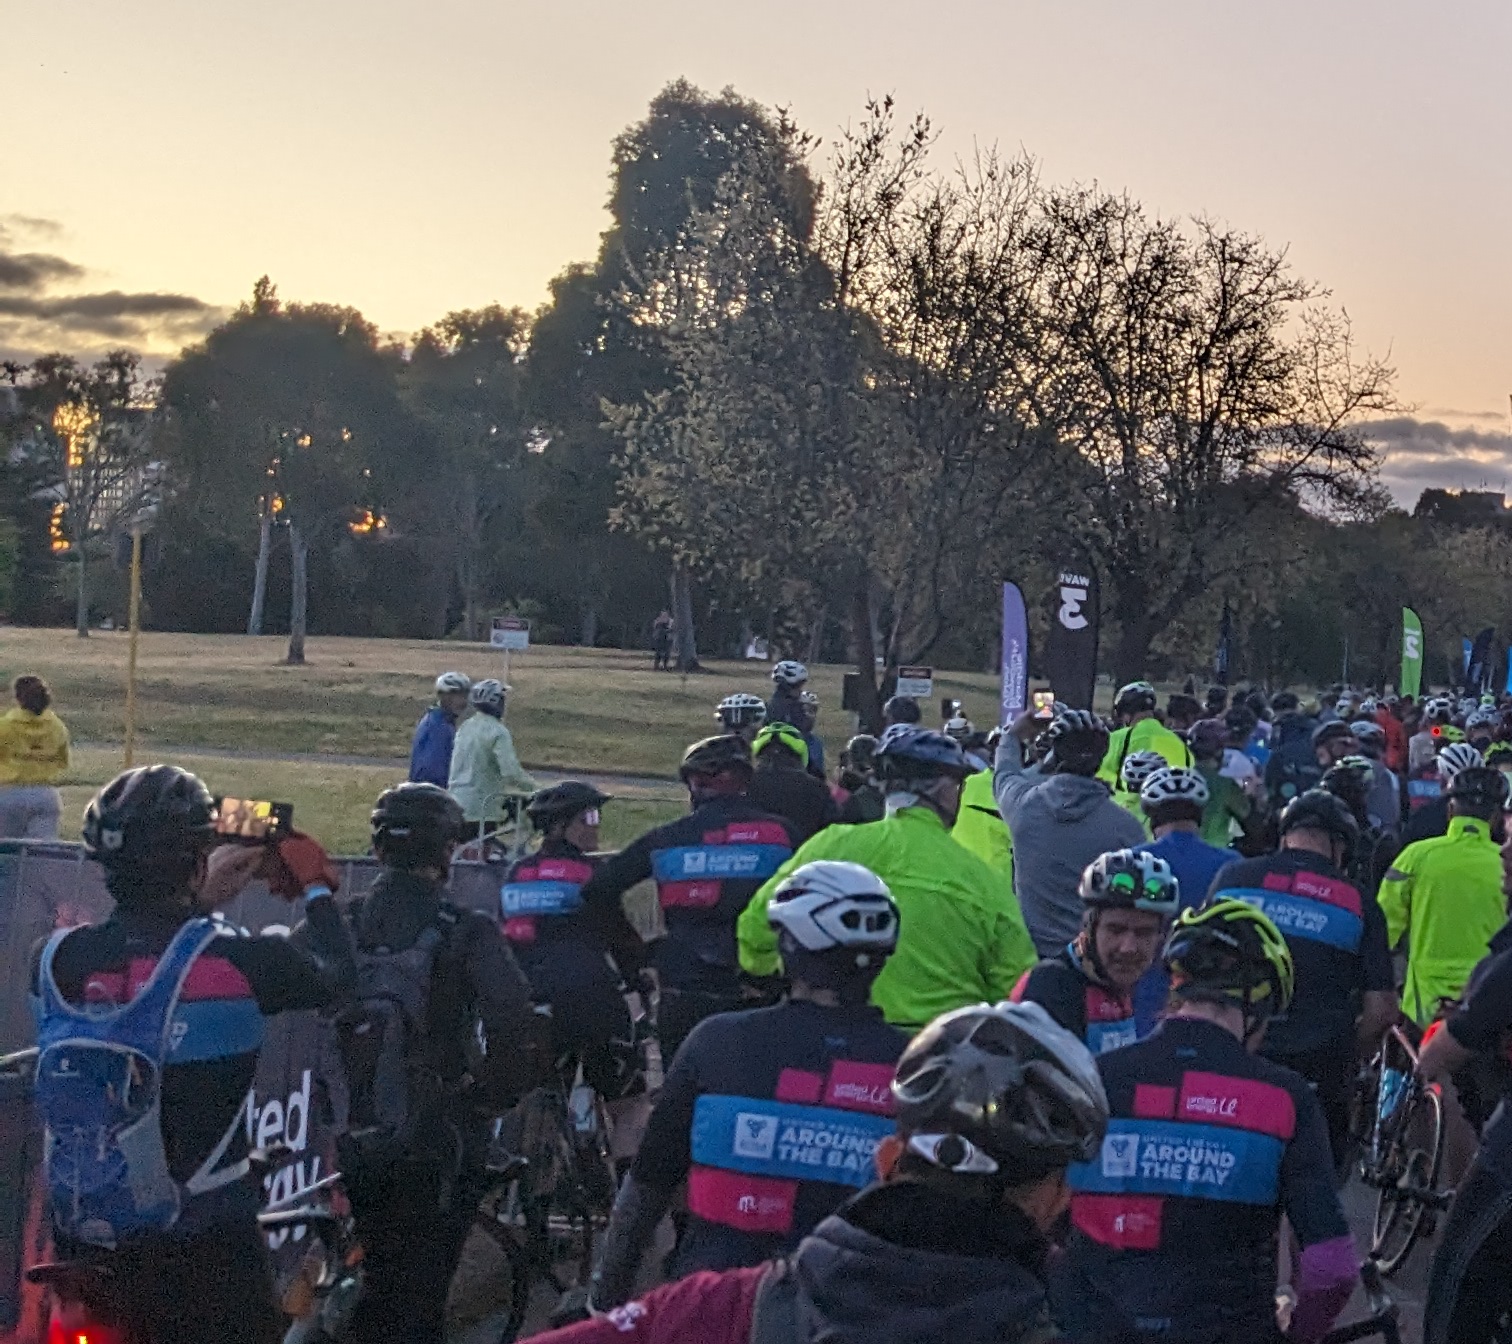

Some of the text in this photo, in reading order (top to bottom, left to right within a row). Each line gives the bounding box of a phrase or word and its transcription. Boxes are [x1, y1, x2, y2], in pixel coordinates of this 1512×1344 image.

[780, 1126, 878, 1156] AROUND
[778, 1145, 871, 1171] THE BAY
[1144, 1143, 1236, 1169] AROUND
[1141, 1161, 1231, 1186] THE BAY
